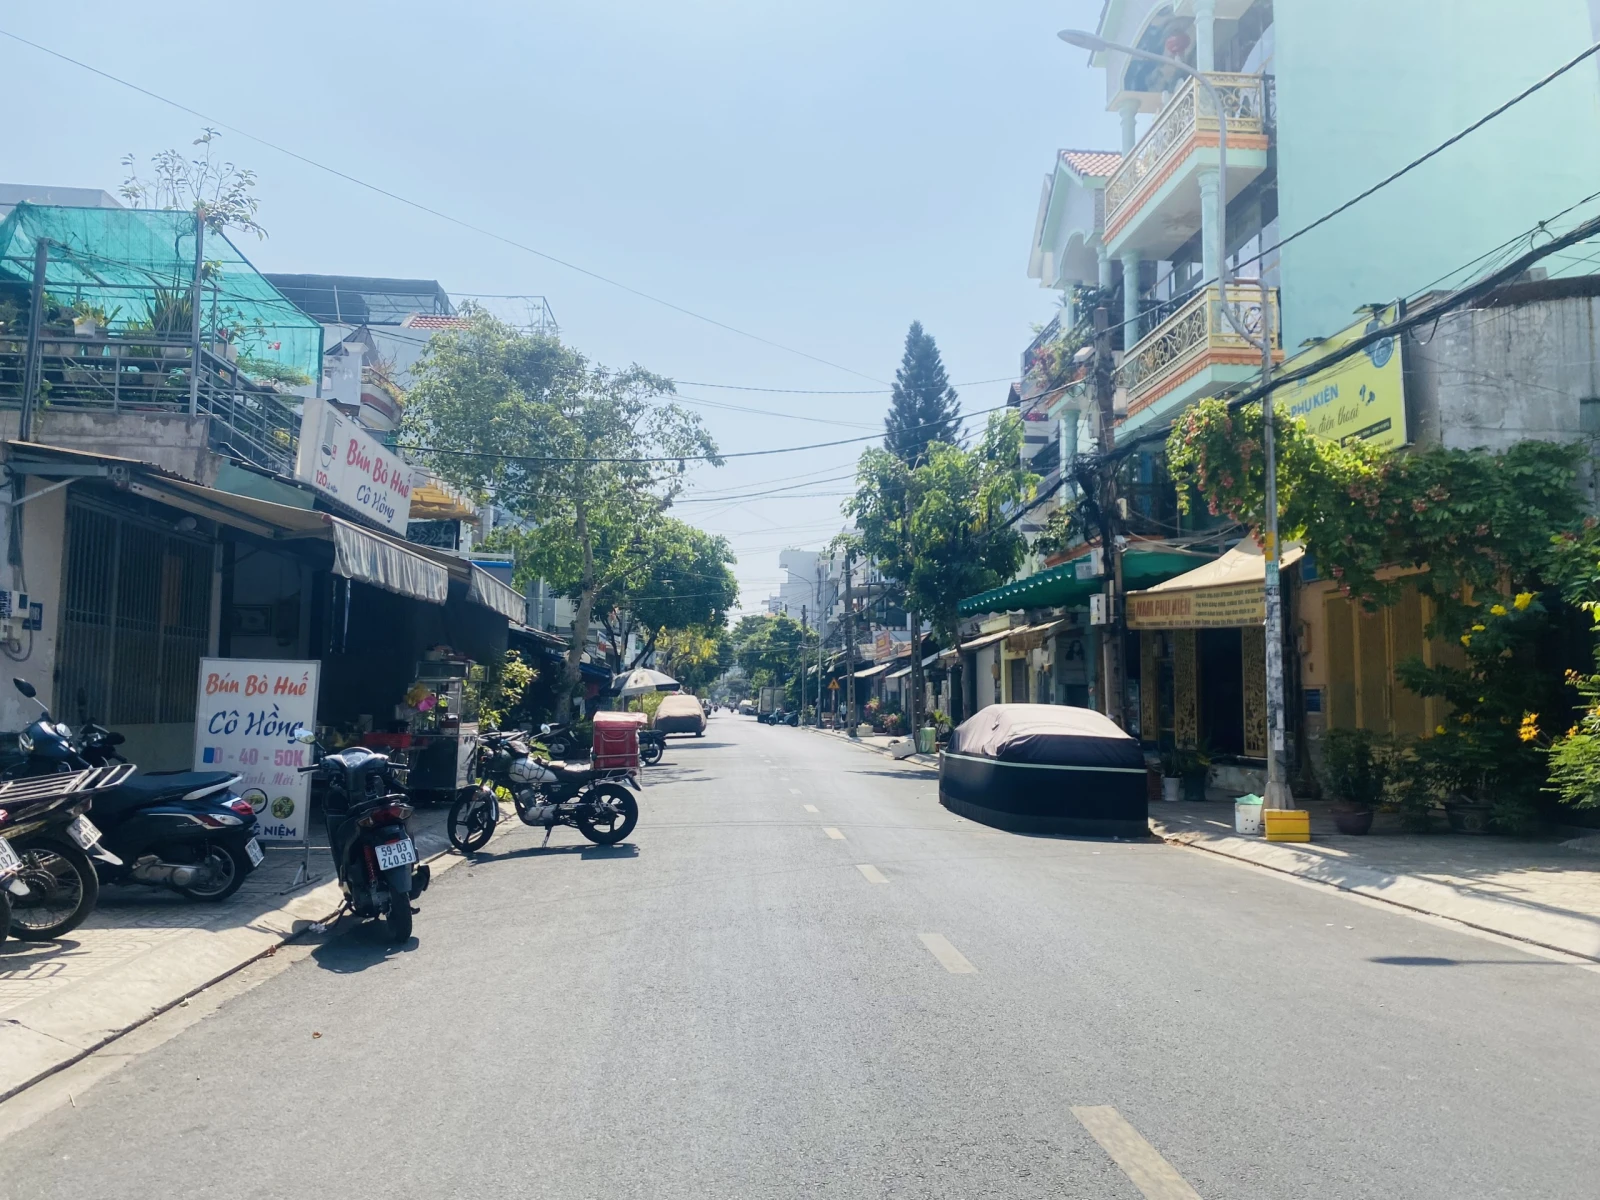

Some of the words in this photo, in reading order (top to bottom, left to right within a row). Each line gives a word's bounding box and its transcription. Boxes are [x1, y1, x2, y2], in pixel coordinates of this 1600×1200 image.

[1291, 397, 1312, 417] PHỤ
[1313, 383, 1339, 408] KIỆN
[1337, 403, 1359, 425] thoại
[346, 438, 371, 474] Bún
[372, 457, 388, 484] Bò
[389, 469, 412, 498] Huế
[356, 484, 371, 504] Cô
[371, 490, 395, 523] Hồng
[1136, 600, 1154, 617] NAM
[205, 672, 239, 696] Bún
[244, 674, 268, 697] Bò
[273, 671, 309, 696] Huế
[208, 709, 240, 735] Cô
[244, 703, 304, 744] Hồng
[239, 748, 259, 766] 40
[274, 749, 305, 767] 50K
[263, 823, 296, 838] NIỆM
